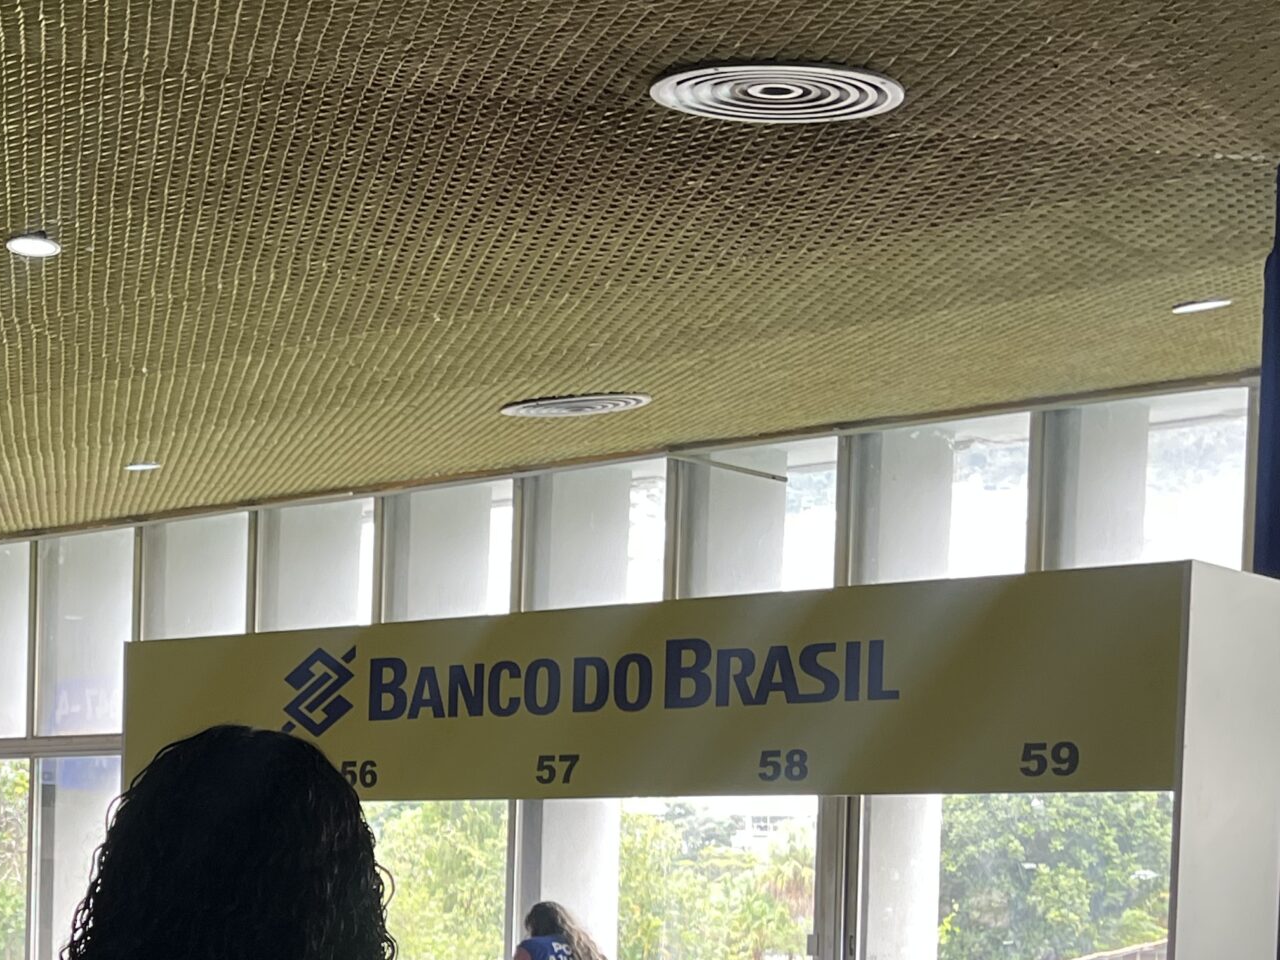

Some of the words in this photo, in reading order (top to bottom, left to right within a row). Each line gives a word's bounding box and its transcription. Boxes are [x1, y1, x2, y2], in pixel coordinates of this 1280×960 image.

[367, 656, 561, 721] BANCO
[571, 652, 653, 713] DO
[663, 637, 901, 710] BRASIL
[341, 760, 378, 788] 56
[535, 754, 580, 784] 57
[758, 748, 808, 781] 58
[1019, 741, 1079, 777] 59
